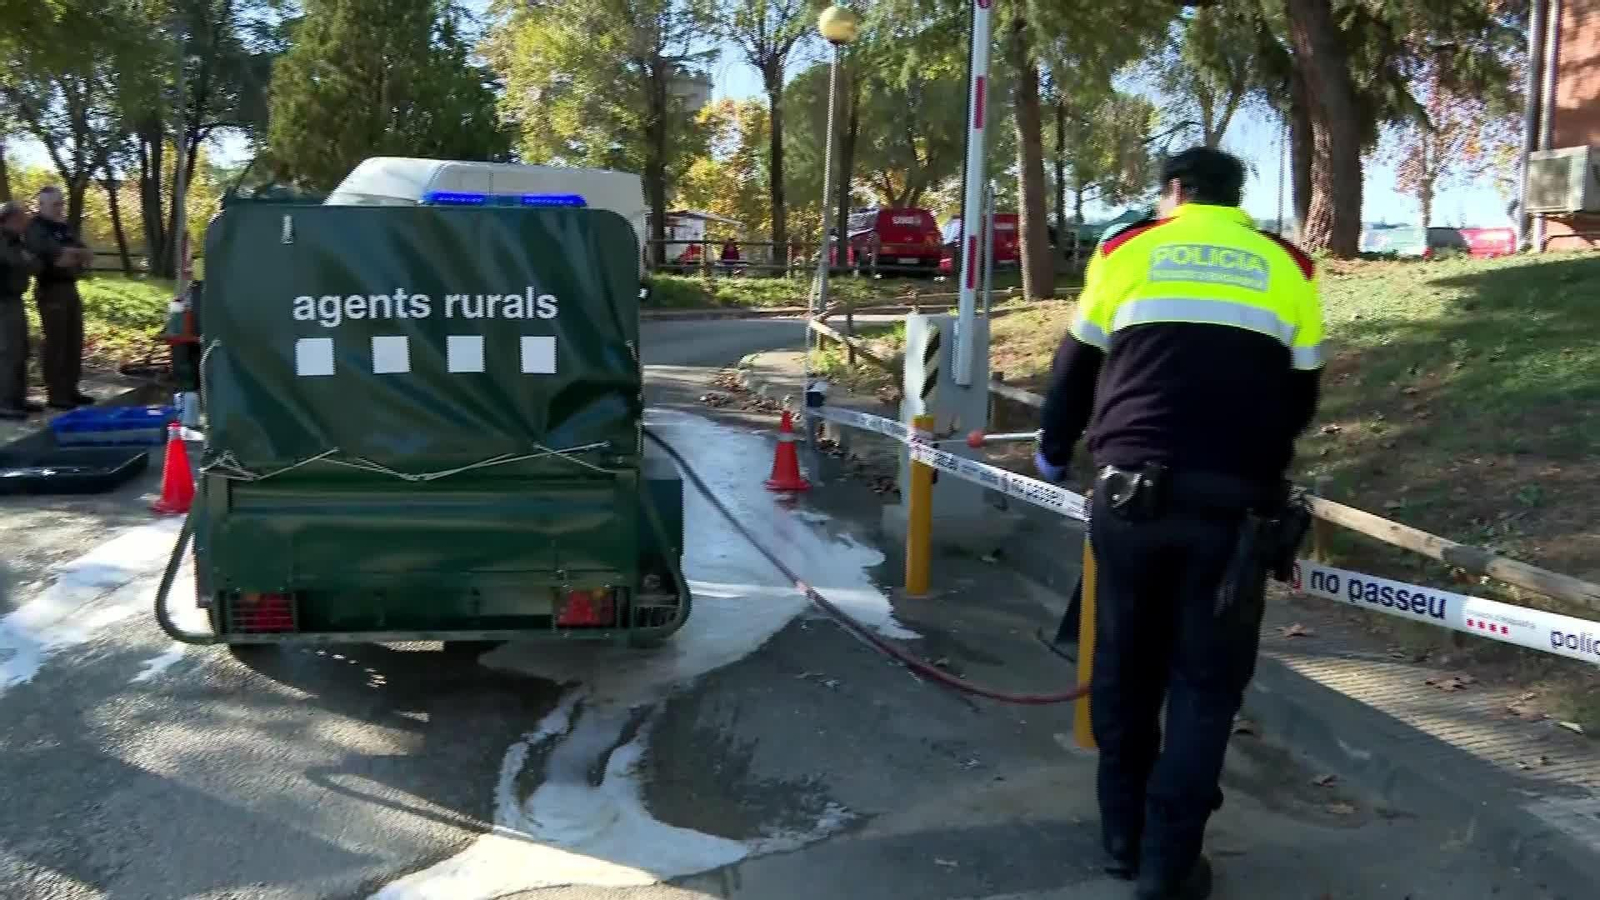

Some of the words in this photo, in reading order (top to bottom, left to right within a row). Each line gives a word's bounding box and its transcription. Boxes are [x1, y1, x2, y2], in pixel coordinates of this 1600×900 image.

[292, 287, 432, 329] agents
[444, 285, 559, 320] rurals
[1310, 569, 1340, 595] no
[1347, 576, 1447, 620] passeu
